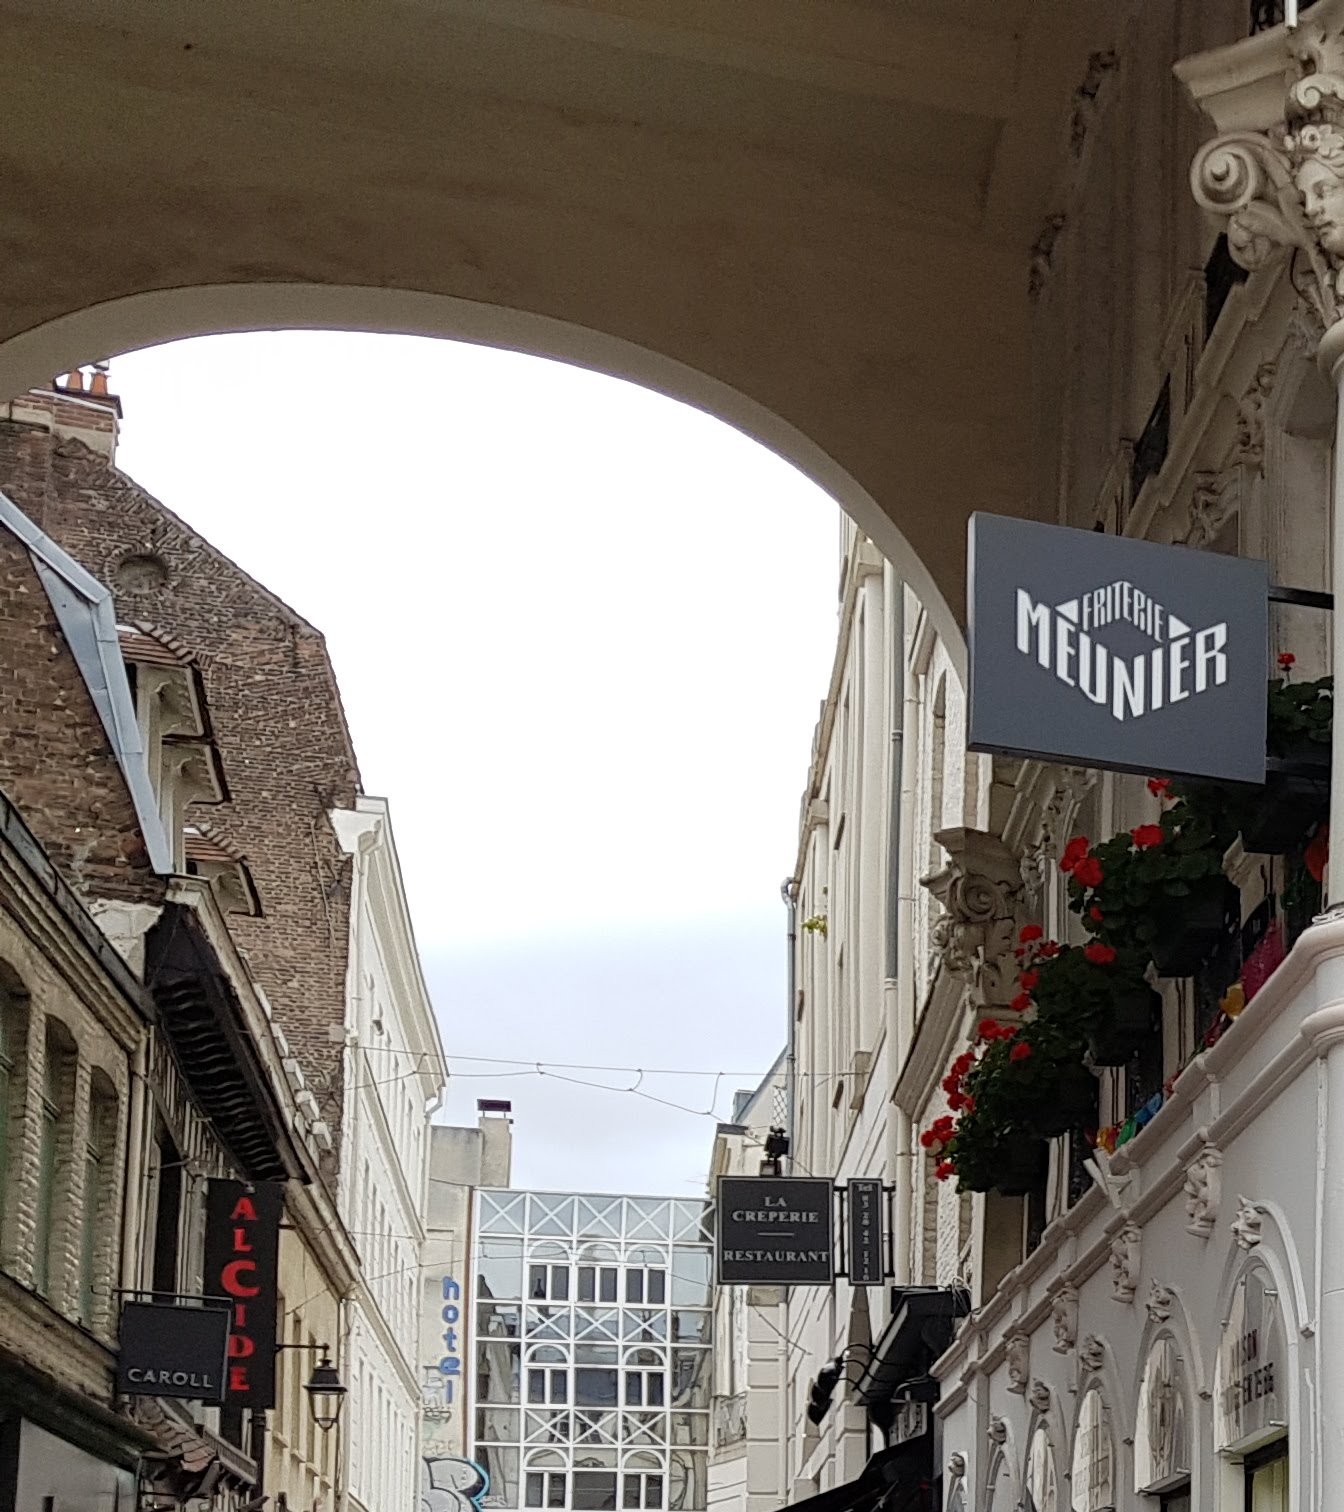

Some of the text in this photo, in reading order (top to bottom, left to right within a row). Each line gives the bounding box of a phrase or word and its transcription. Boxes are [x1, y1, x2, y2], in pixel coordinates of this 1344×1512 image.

[1082, 580, 1164, 643] FRITERIE
[1016, 587, 1228, 722] MEUNIER
[732, 1210, 819, 1223] CREPERIE
[764, 1196, 787, 1207] LA
[723, 1250, 829, 1262] RESTAURANT
[221, 1196, 260, 1392] ALCIDE
[439, 1275, 461, 1404] hotel
[127, 1367, 215, 1388] CAROLL
